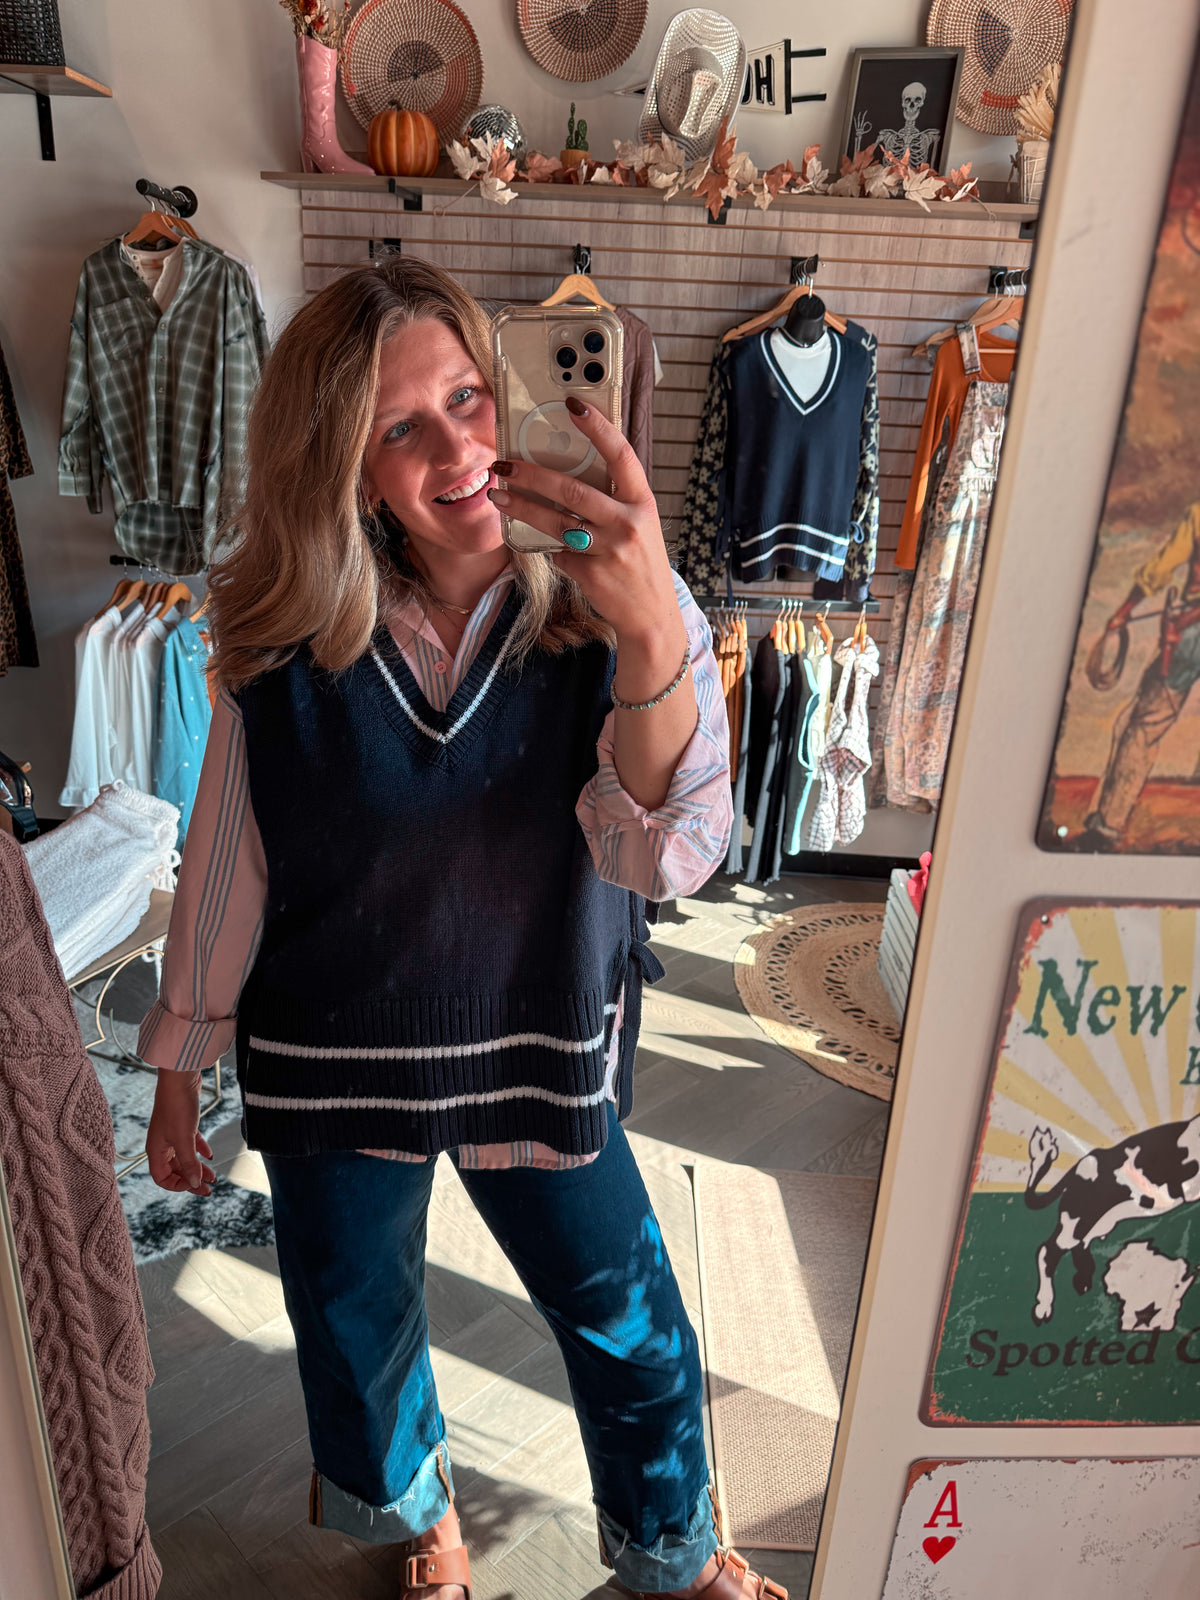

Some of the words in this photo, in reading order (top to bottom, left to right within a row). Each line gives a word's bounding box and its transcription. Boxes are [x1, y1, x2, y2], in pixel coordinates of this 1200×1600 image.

[1023, 958, 1187, 1039] New
[966, 1326, 1161, 1376] Spotted
[923, 1480, 963, 1528] A
